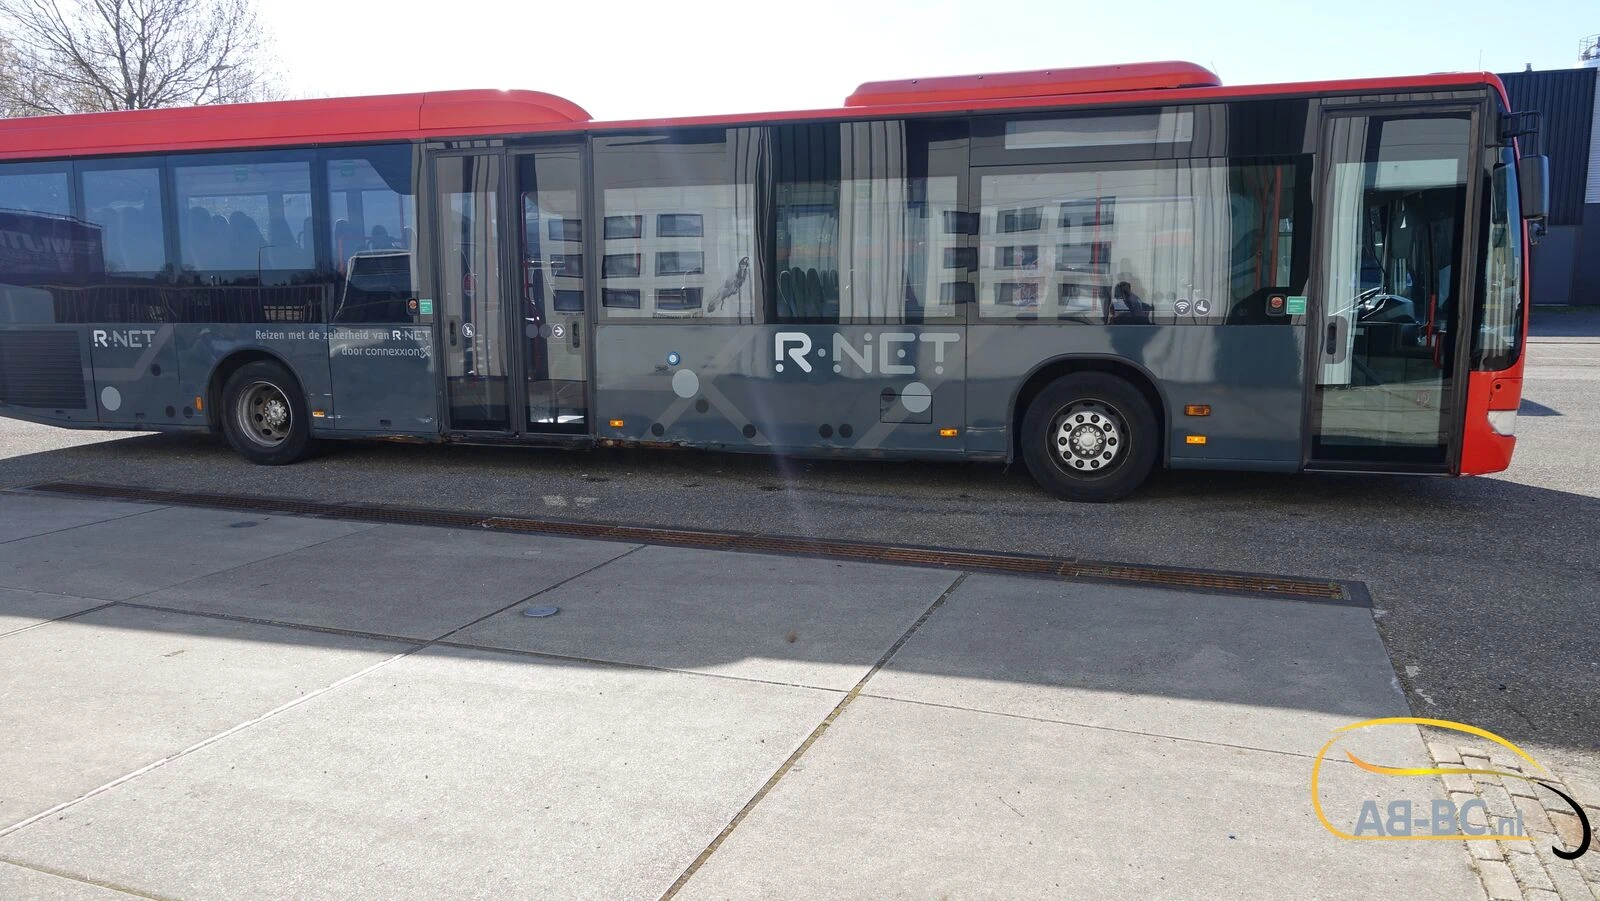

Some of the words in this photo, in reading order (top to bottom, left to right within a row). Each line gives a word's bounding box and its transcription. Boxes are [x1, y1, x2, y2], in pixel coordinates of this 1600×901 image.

[255, 329, 285, 340] Reizen
[288, 330, 306, 340] met
[308, 329, 320, 340] de
[323, 329, 369, 340] zekerheid
[372, 331, 390, 340] van
[341, 345, 363, 356] door
